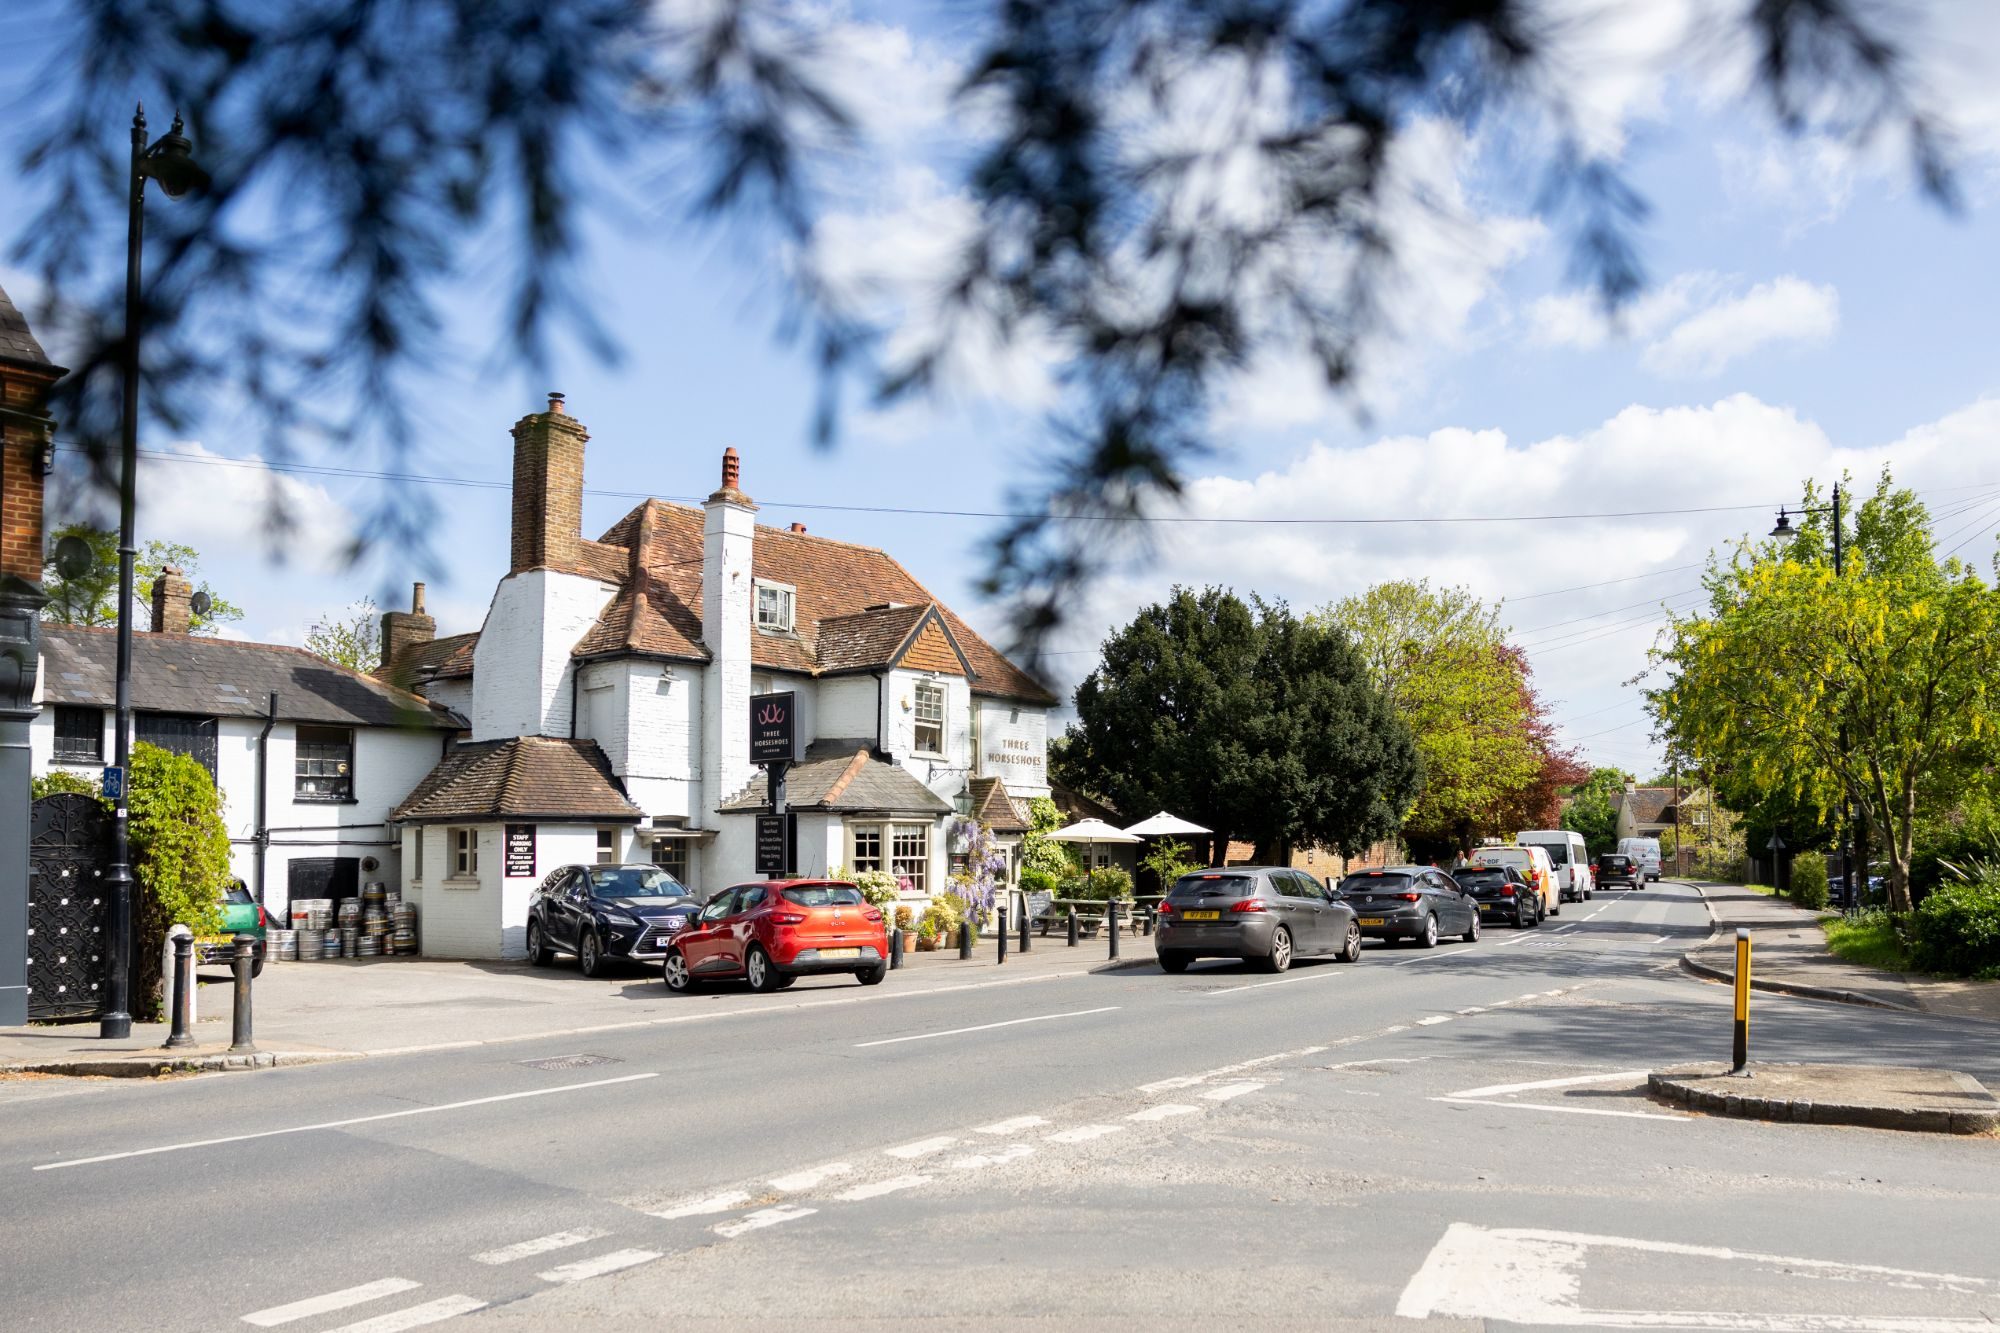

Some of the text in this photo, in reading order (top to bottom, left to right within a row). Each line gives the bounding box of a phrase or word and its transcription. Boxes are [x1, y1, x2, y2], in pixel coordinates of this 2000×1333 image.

[754, 739, 788, 747] HORSESHOES
[1002, 739, 1029, 751] THREE
[988, 753, 1041, 766] HORSESHOES
